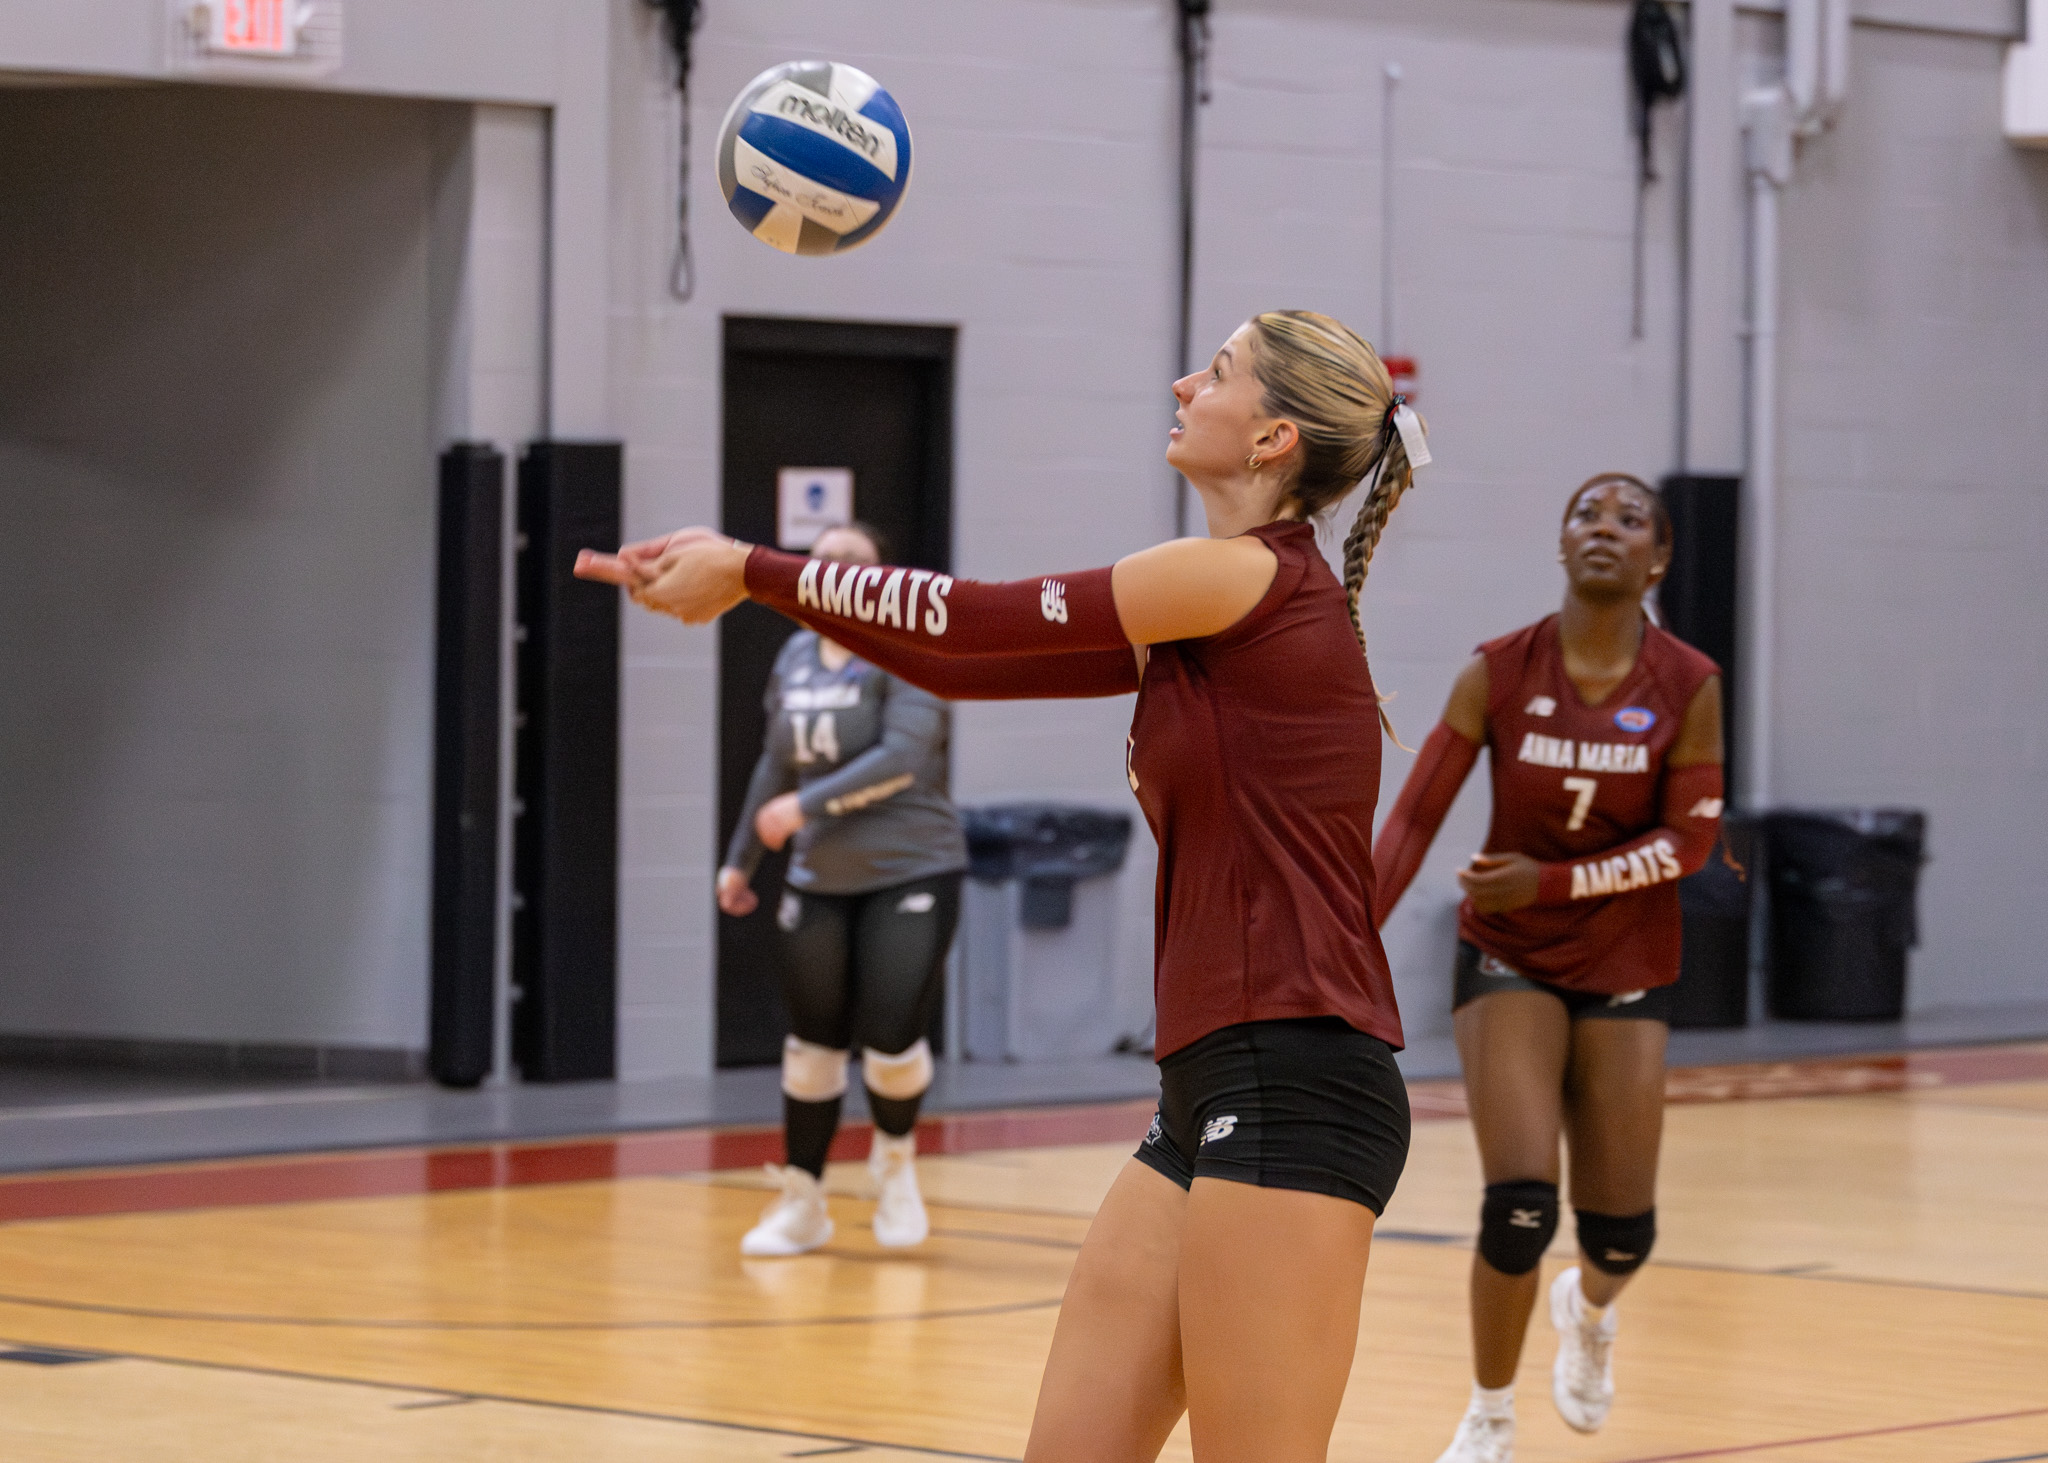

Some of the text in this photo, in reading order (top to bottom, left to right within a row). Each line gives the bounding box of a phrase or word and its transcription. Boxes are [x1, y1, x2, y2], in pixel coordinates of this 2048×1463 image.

[777, 94, 880, 158] molten
[797, 558, 953, 636] AMCATS
[790, 711, 839, 763] 14
[1518, 731, 1649, 773] ANNA MARIA
[1563, 776, 1597, 831] 7
[1570, 838, 1682, 900] AMCATS
